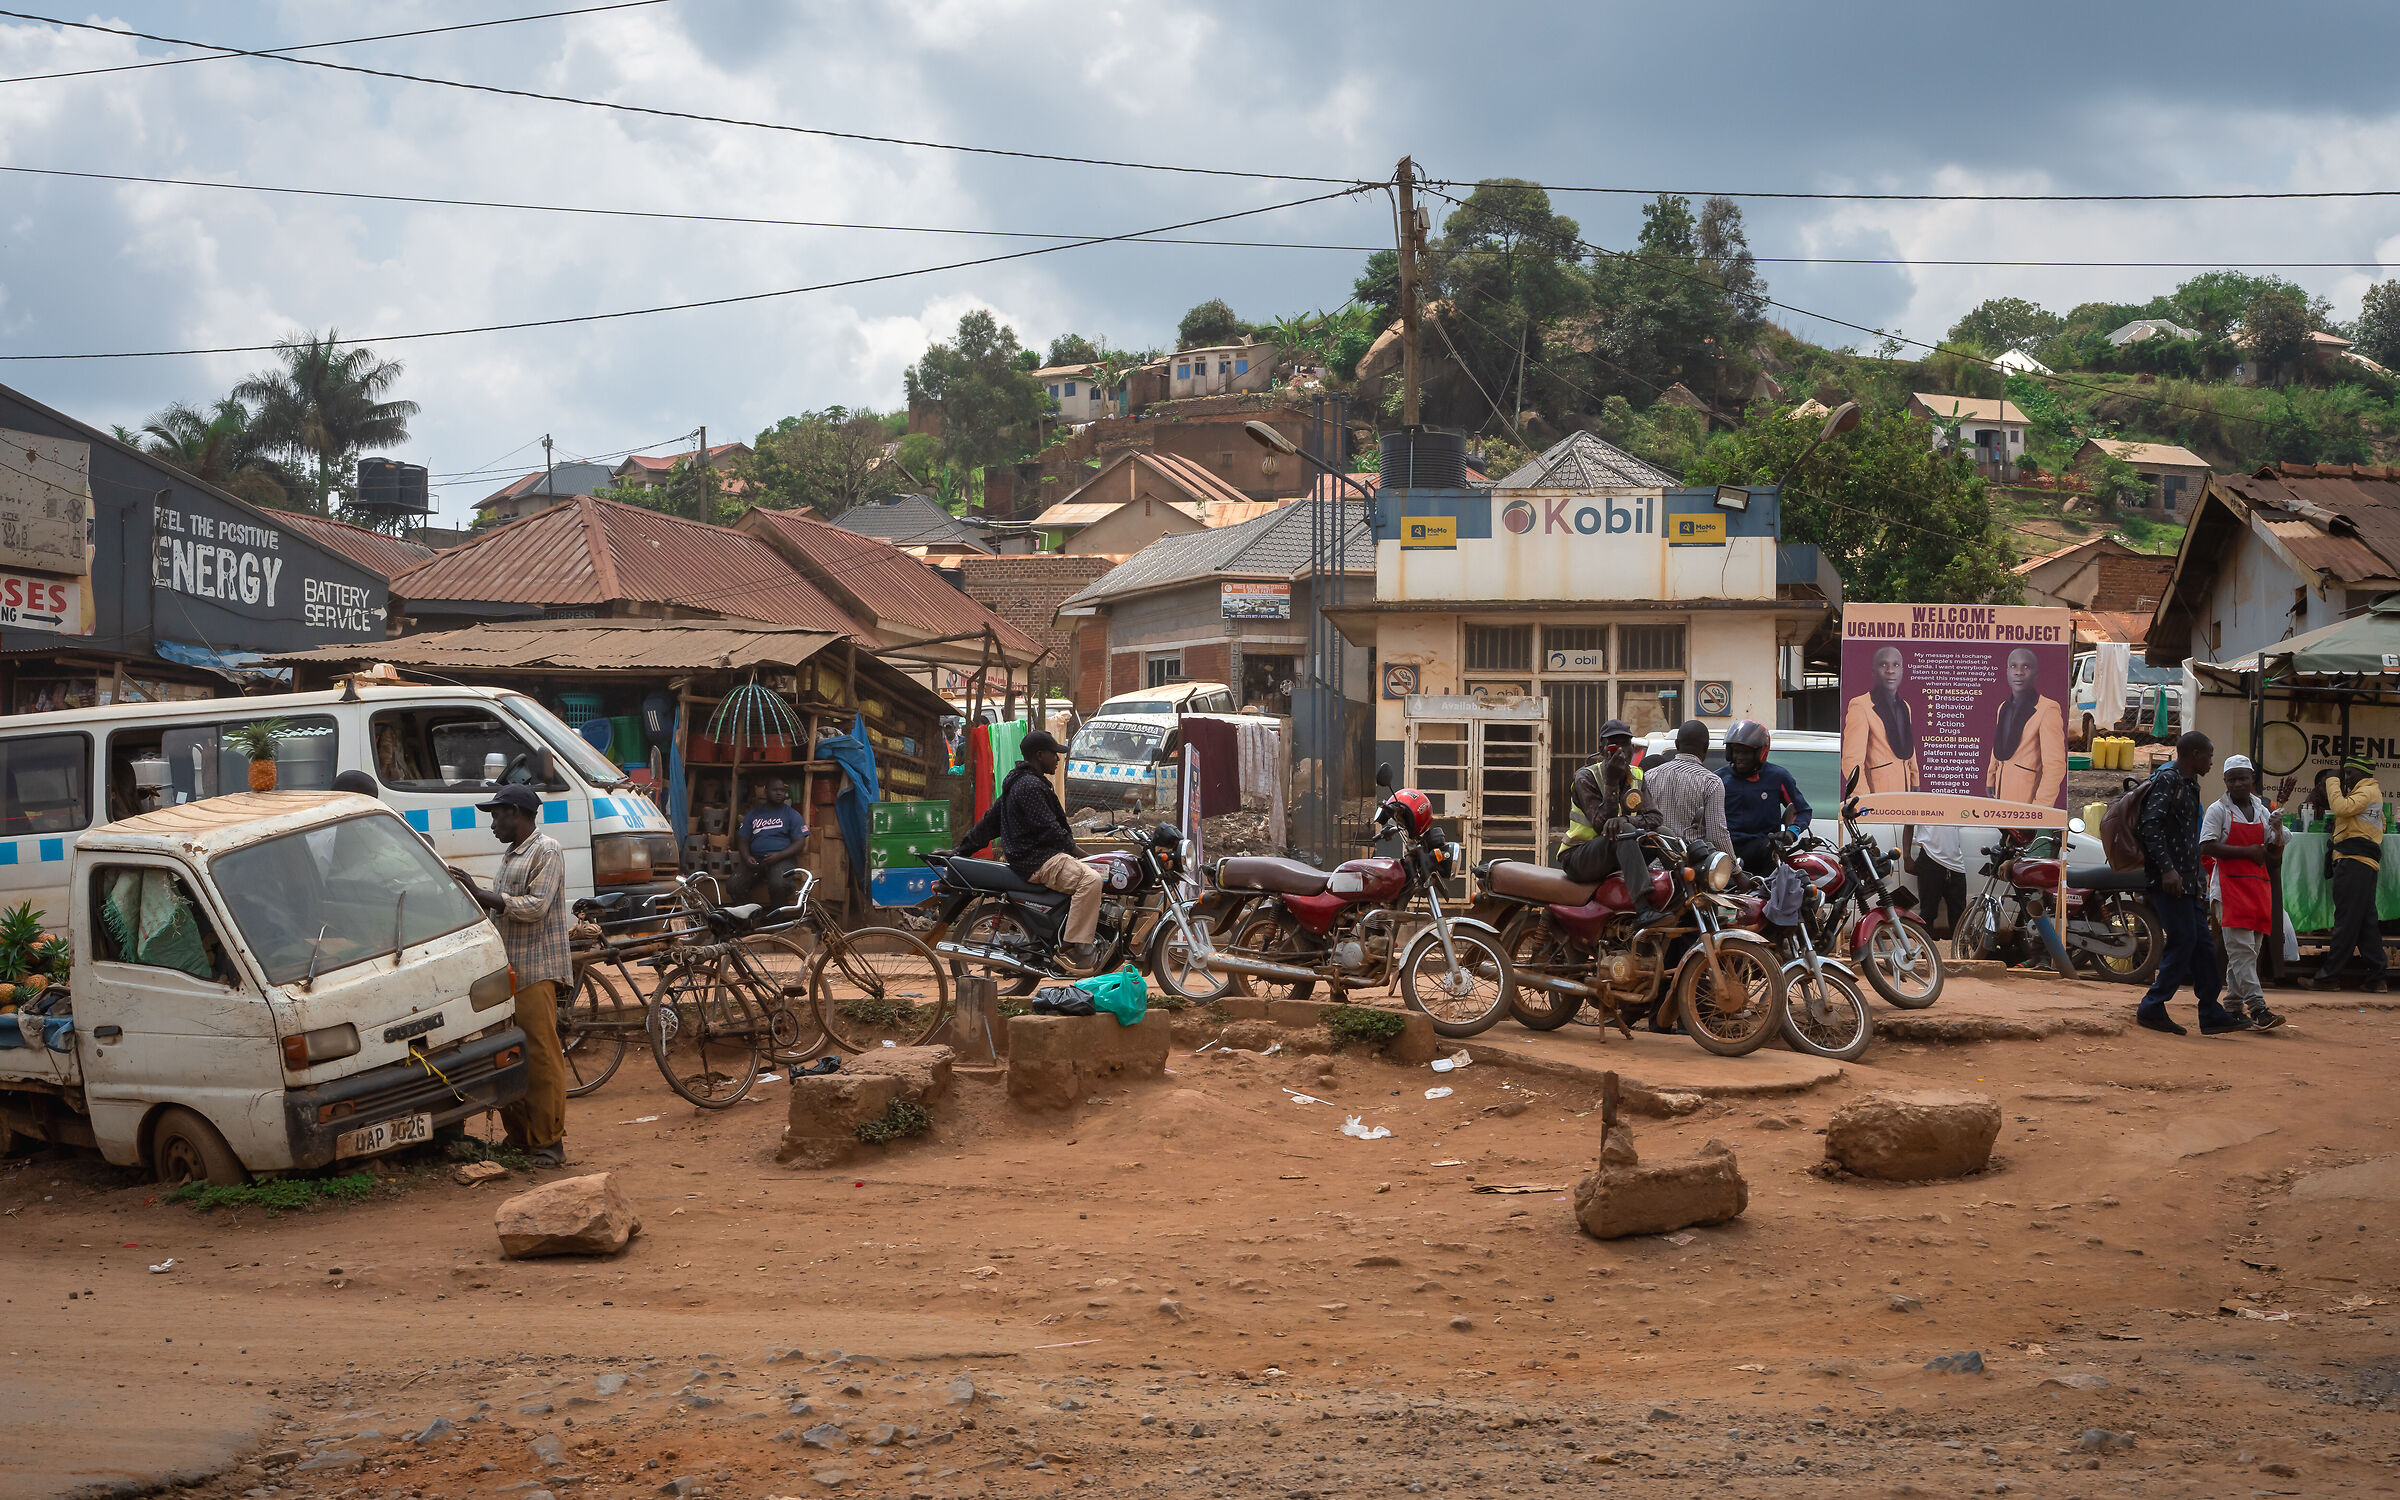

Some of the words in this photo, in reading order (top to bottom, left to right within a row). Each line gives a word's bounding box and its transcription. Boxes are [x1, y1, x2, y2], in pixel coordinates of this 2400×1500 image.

[1545, 498, 1653, 535] Kobil
[190, 514, 214, 538] THE
[219, 521, 279, 550] POSITIVE
[152, 535, 282, 607] ENERGY
[0, 578, 67, 614] SES
[304, 578, 370, 608] BATTERY
[304, 603, 371, 632] SERVICE
[1912, 607, 1996, 624] WELCOME
[1847, 622, 1906, 638] UGANDA
[1911, 623, 1990, 640] BRIANCOM
[1995, 625, 2061, 642] PROJECT
[1574, 655, 1597, 665] obil
[1936, 712, 1965, 720] Speech
[1983, 810, 2043, 820] 0743792388
